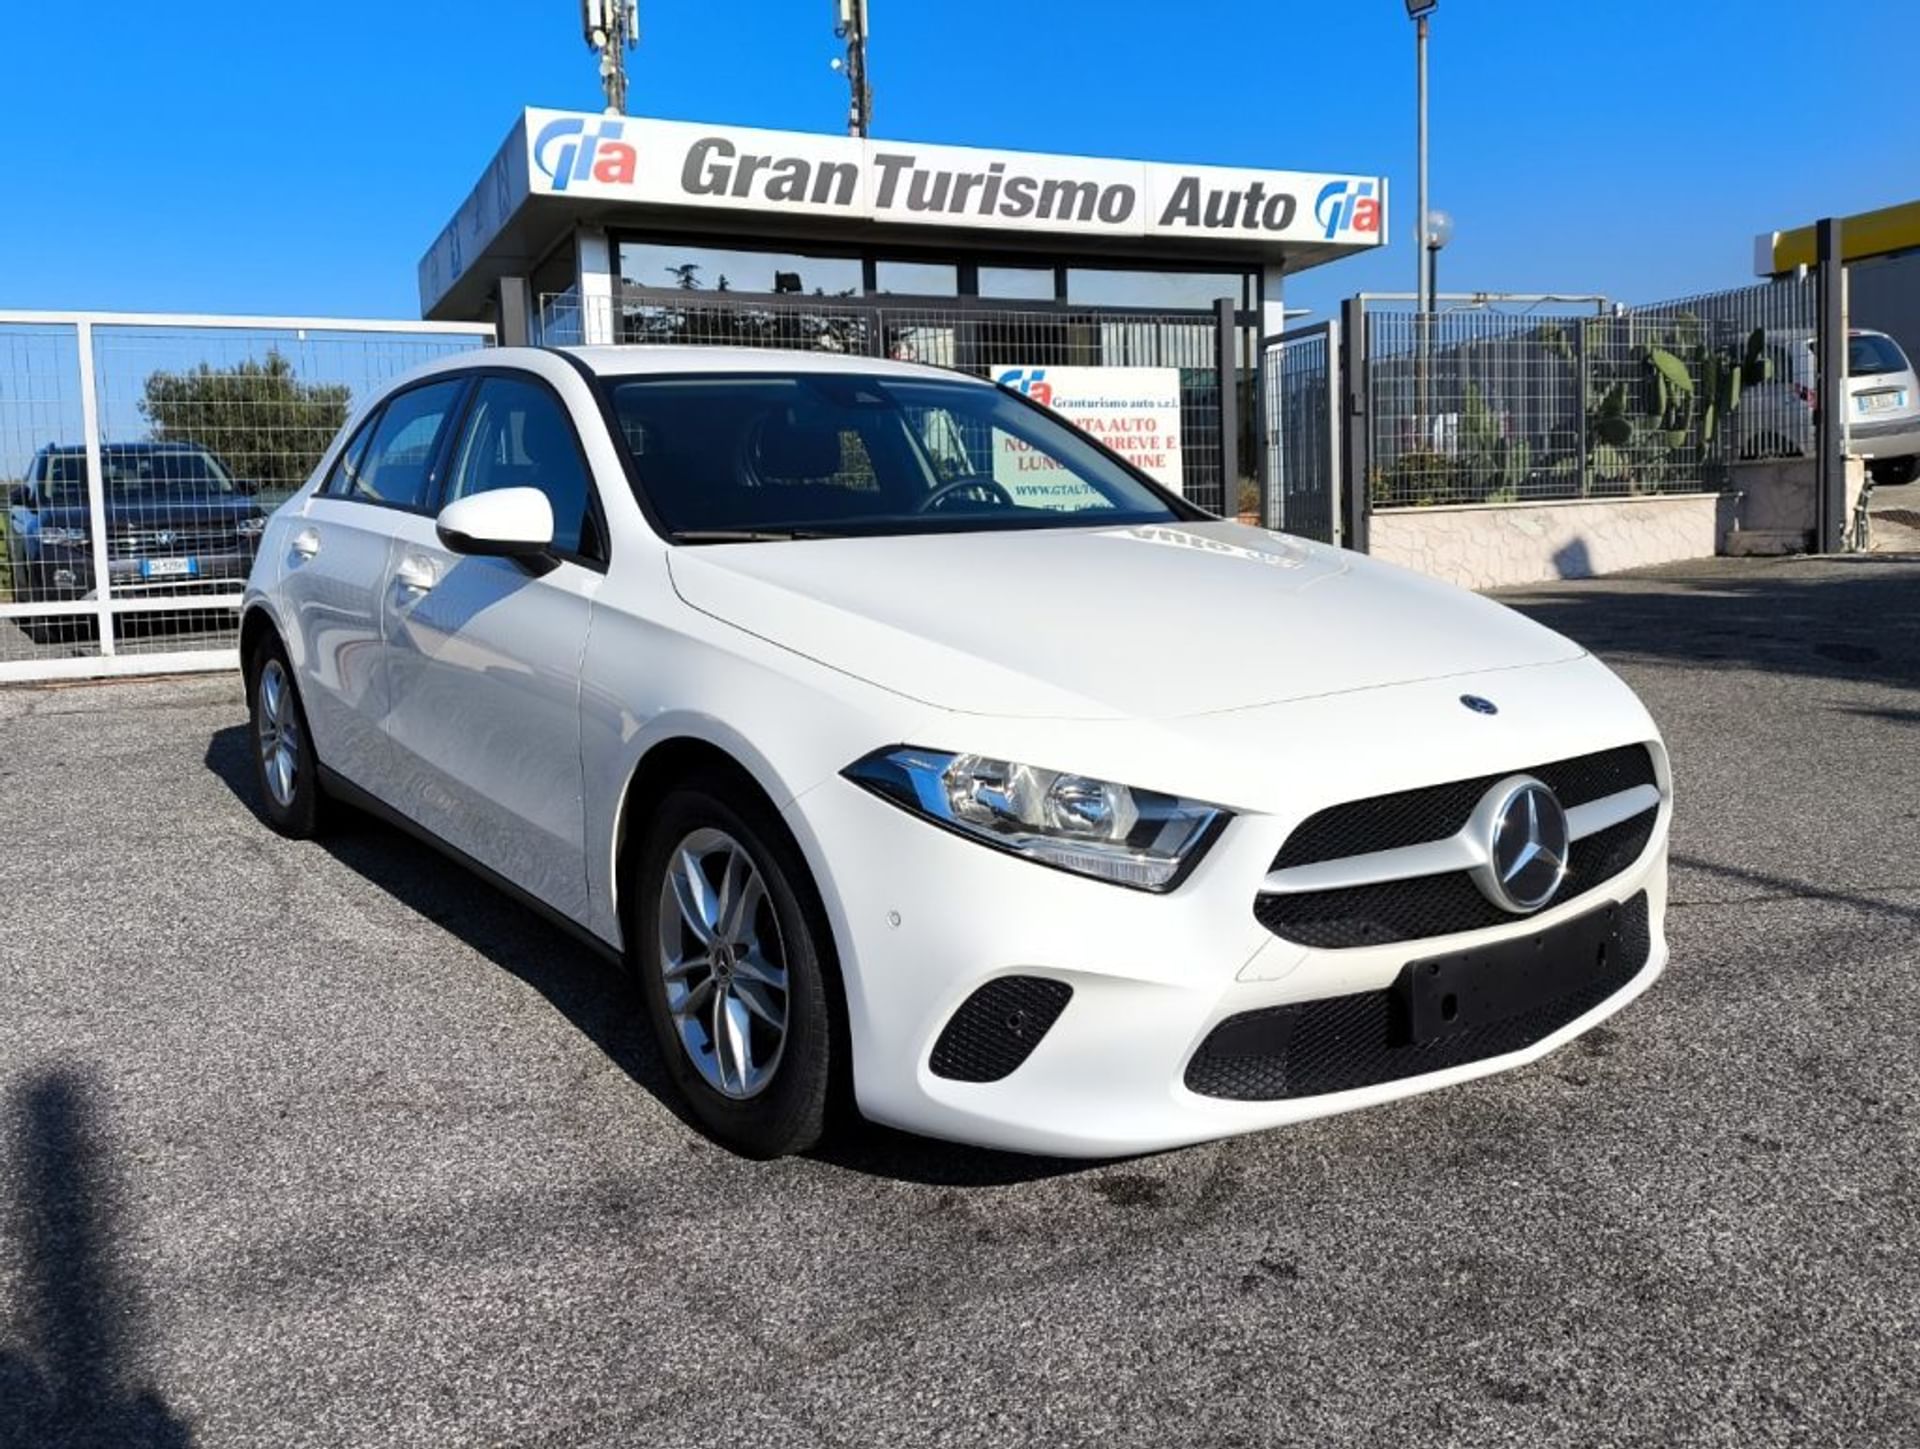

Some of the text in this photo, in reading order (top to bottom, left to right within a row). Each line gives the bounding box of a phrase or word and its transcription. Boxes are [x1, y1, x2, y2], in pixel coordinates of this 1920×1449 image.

[681, 137, 1297, 232] Gran Turismo Auto
[1053, 397, 1128, 408] Granturismo
[1130, 398, 1154, 408] auto
[1109, 418, 1157, 432] AUTO
[1102, 436, 1177, 449] BREVE E
